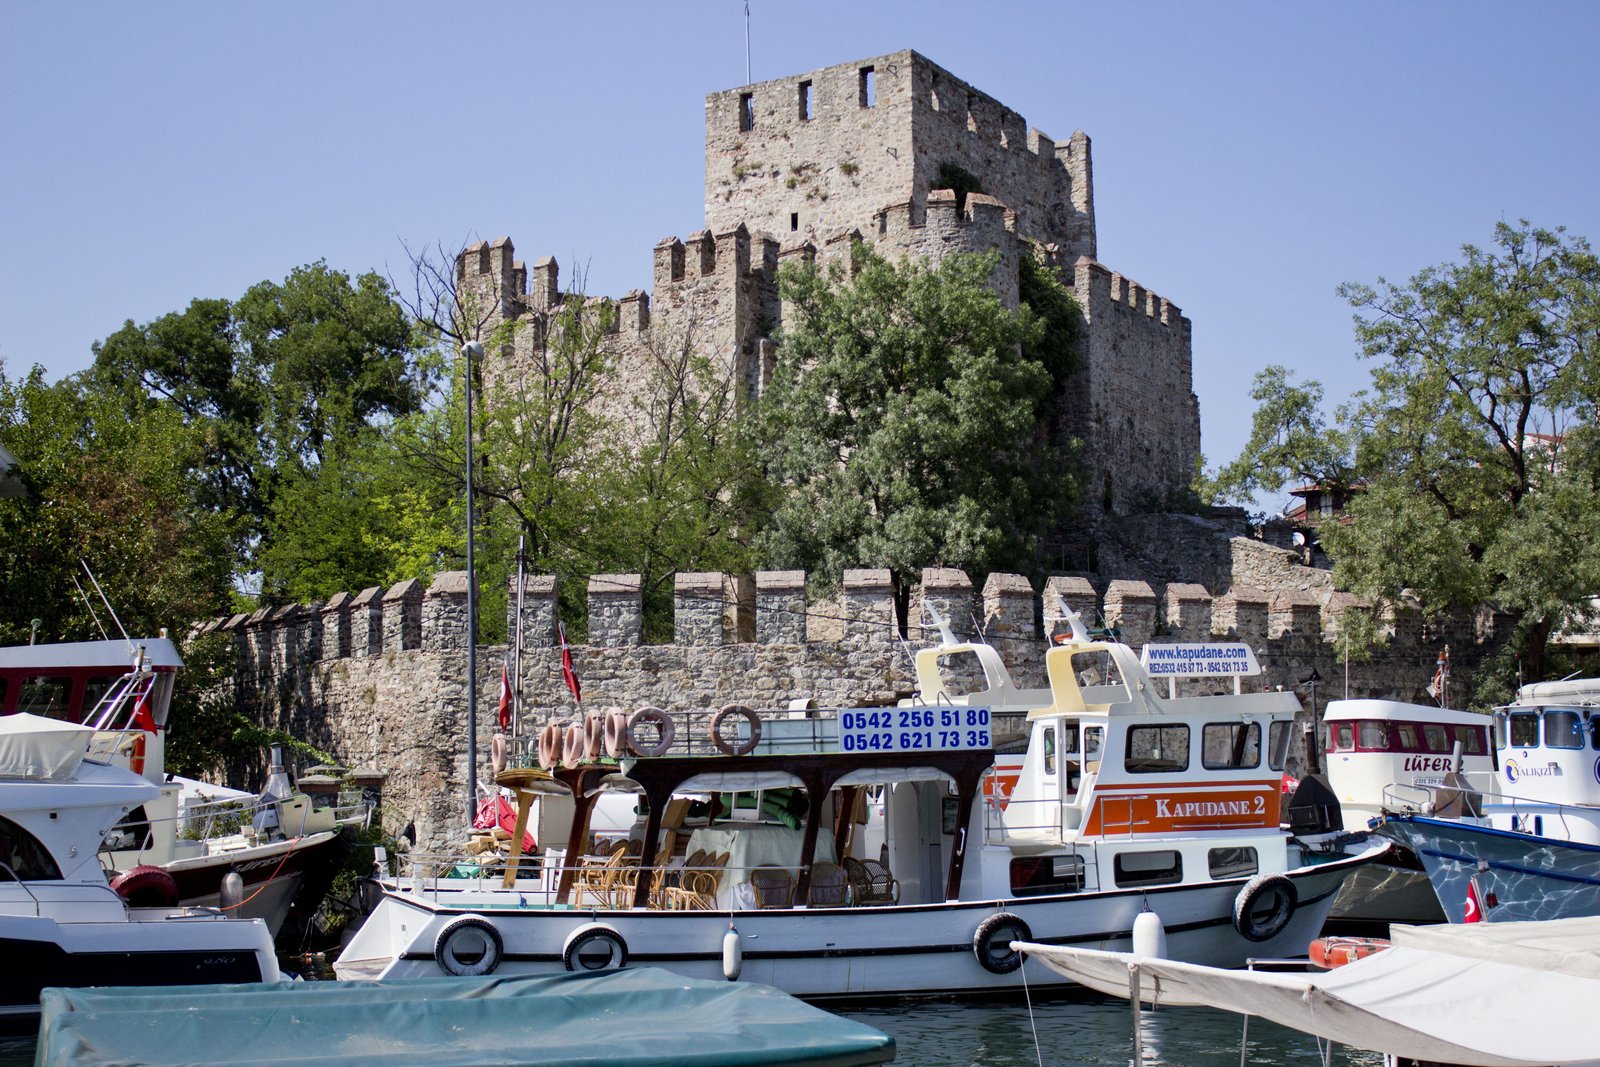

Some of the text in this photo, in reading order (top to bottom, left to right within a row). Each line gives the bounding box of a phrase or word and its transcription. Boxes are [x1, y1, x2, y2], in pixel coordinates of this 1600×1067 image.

[1149, 645, 1247, 661] www.kapudane.com
[1196, 662, 1204, 672] 73
[1207, 662, 1221, 673] 0542
[1221, 662, 1232, 672] 621
[1233, 662, 1240, 672] 73
[1241, 661, 1248, 672] 35
[842, 709, 989, 729] 0542 256 51 80
[843, 730, 989, 751] 0542 621 73 35
[1404, 755, 1452, 771] LÜFER
[1155, 796, 1265, 818] KAPUDANE 2
